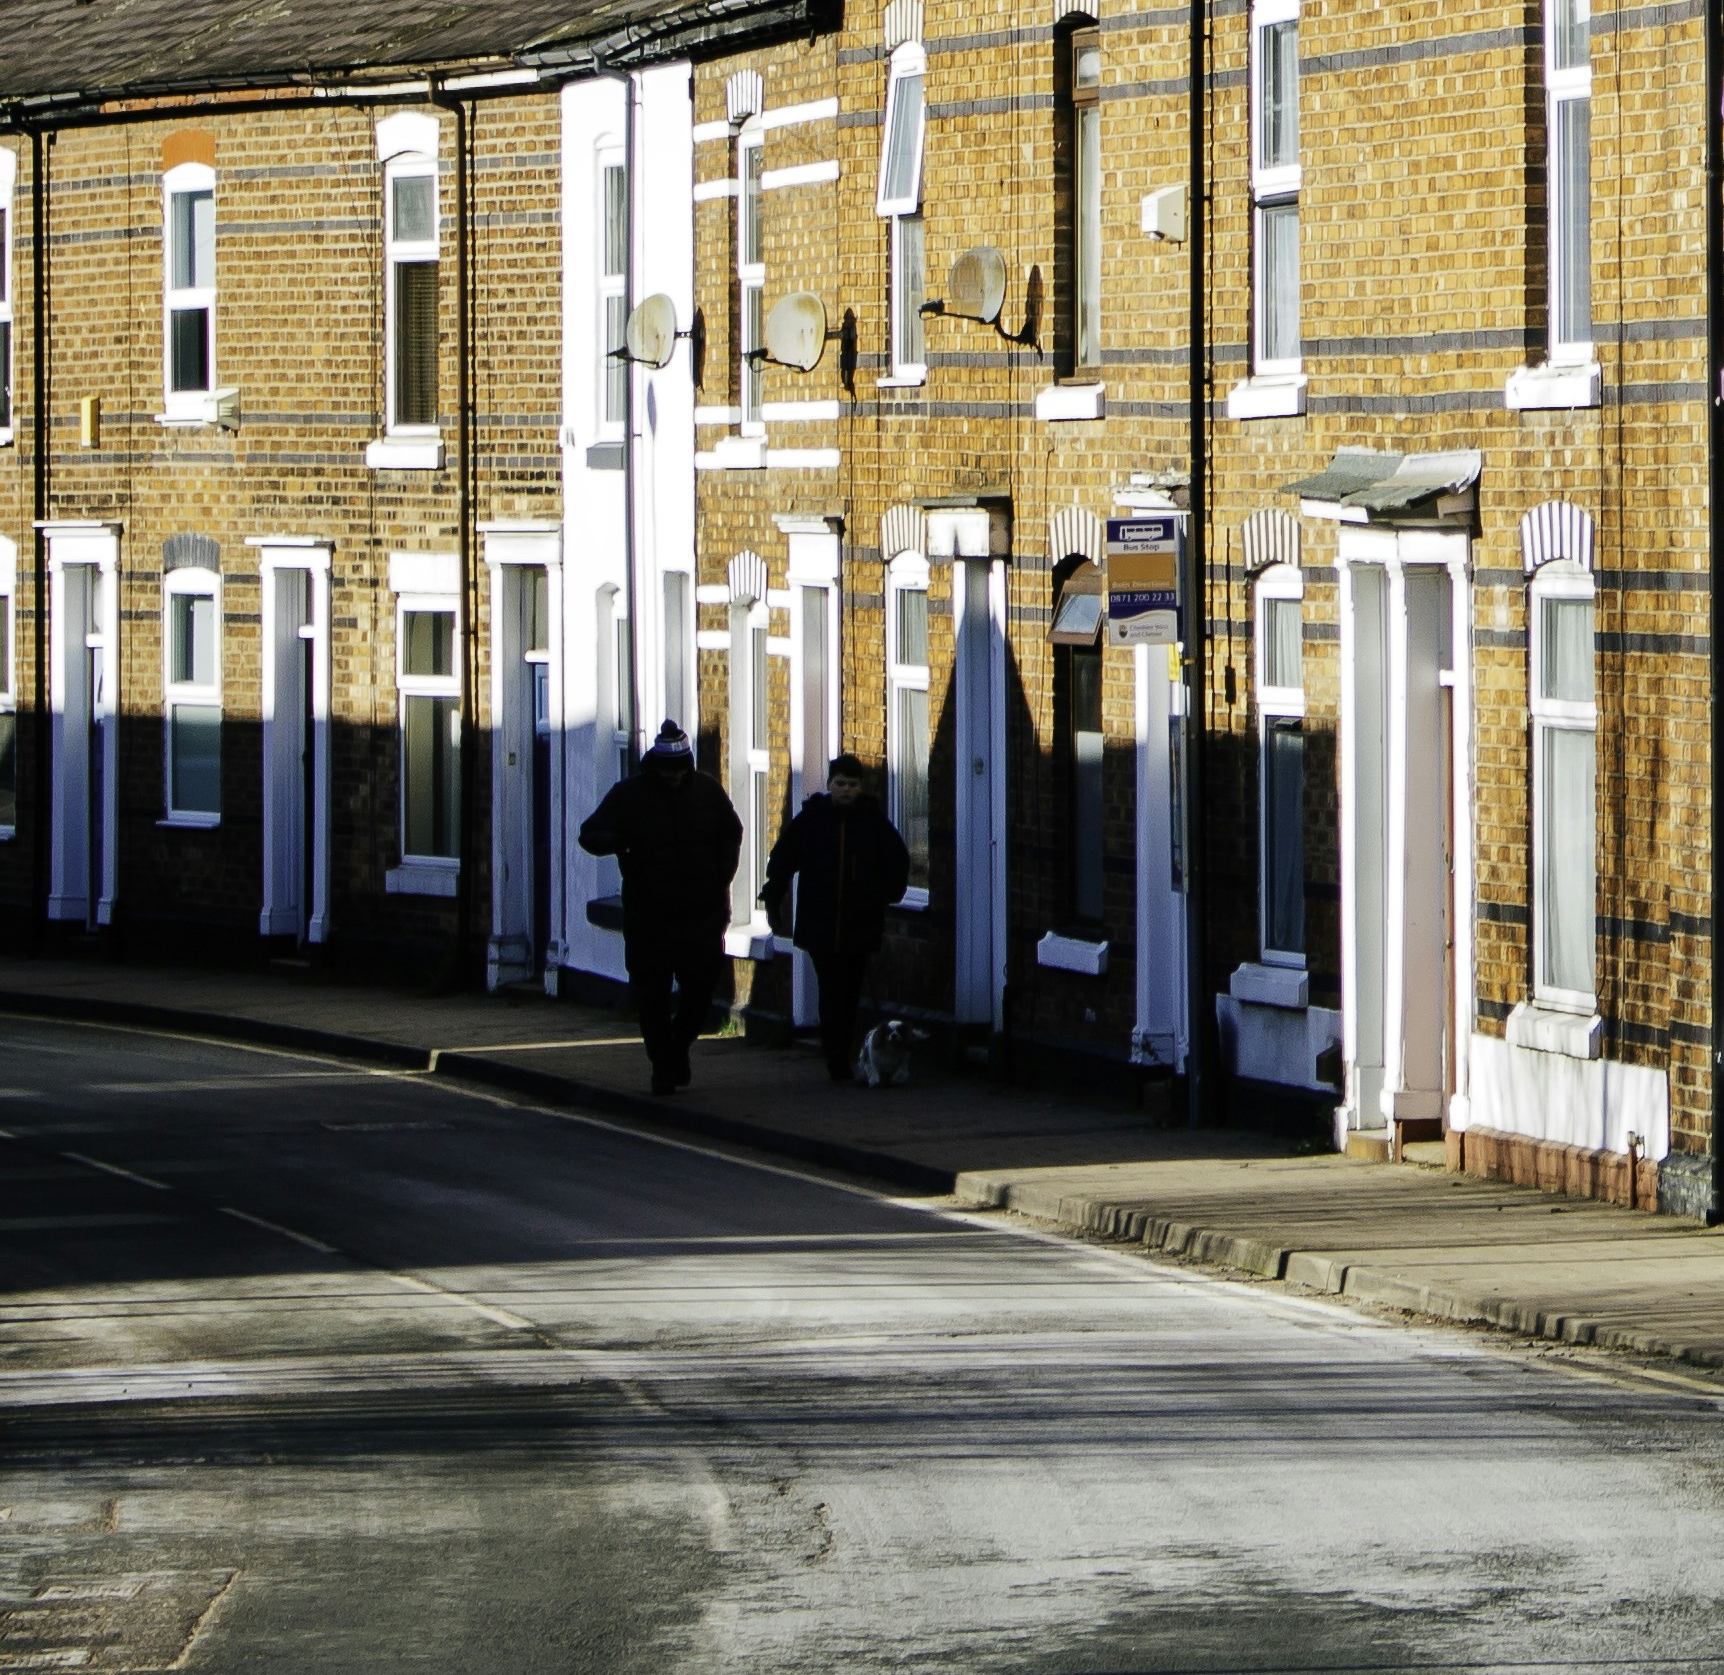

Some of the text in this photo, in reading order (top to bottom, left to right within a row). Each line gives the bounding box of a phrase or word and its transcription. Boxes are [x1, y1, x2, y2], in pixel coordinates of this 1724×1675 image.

[1140, 544, 1159, 552] Stop
[1134, 593, 1150, 603] 200
[1152, 592, 1162, 602] 22
